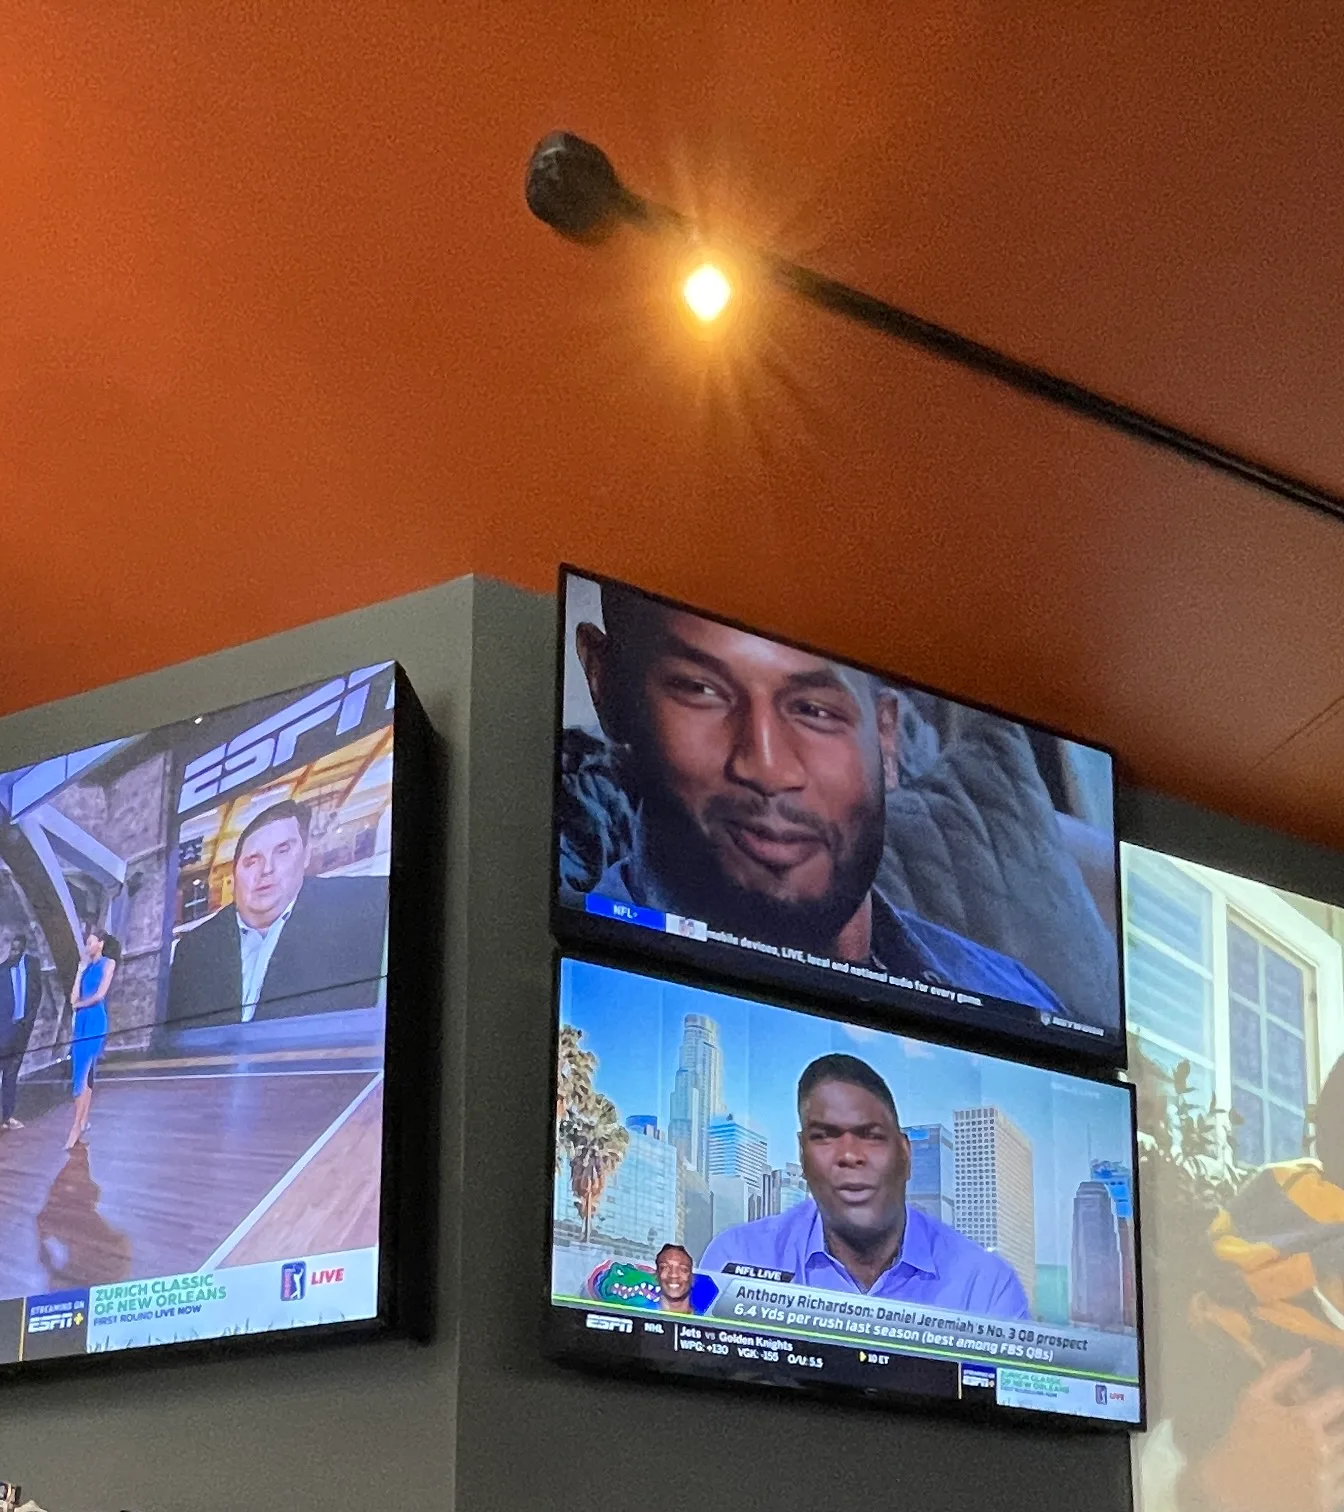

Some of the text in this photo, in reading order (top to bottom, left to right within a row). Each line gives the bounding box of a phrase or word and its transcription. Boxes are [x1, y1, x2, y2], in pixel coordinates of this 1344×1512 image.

[311, 1268, 344, 1285] LIVE
[735, 1266, 782, 1281] NFL LIVE
[94, 1286, 227, 1315] OF NEW ORLEANS
[95, 1274, 214, 1301] ZURICH CLASSIC
[155, 1307, 175, 1318] LIVE
[178, 1304, 202, 1314] NOW
[586, 1314, 633, 1333] ESPN
[736, 1286, 1088, 1350] Anthony Richardson: Daniel Jeremiah's No. 3 QB prospect
[680, 1326, 701, 1339] Jets
[719, 1333, 754, 1347] Golden
[756, 1337, 793, 1352] Knights
[734, 1304, 756, 1317] 6.4
[761, 1309, 784, 1322] Yds
[786, 1312, 809, 1325] per
[813, 1315, 843, 1329] rush
[846, 1319, 870, 1334] last
[873, 1325, 919, 1338] season
[922, 1330, 954, 1346] (best
[956, 1339, 997, 1354] among
